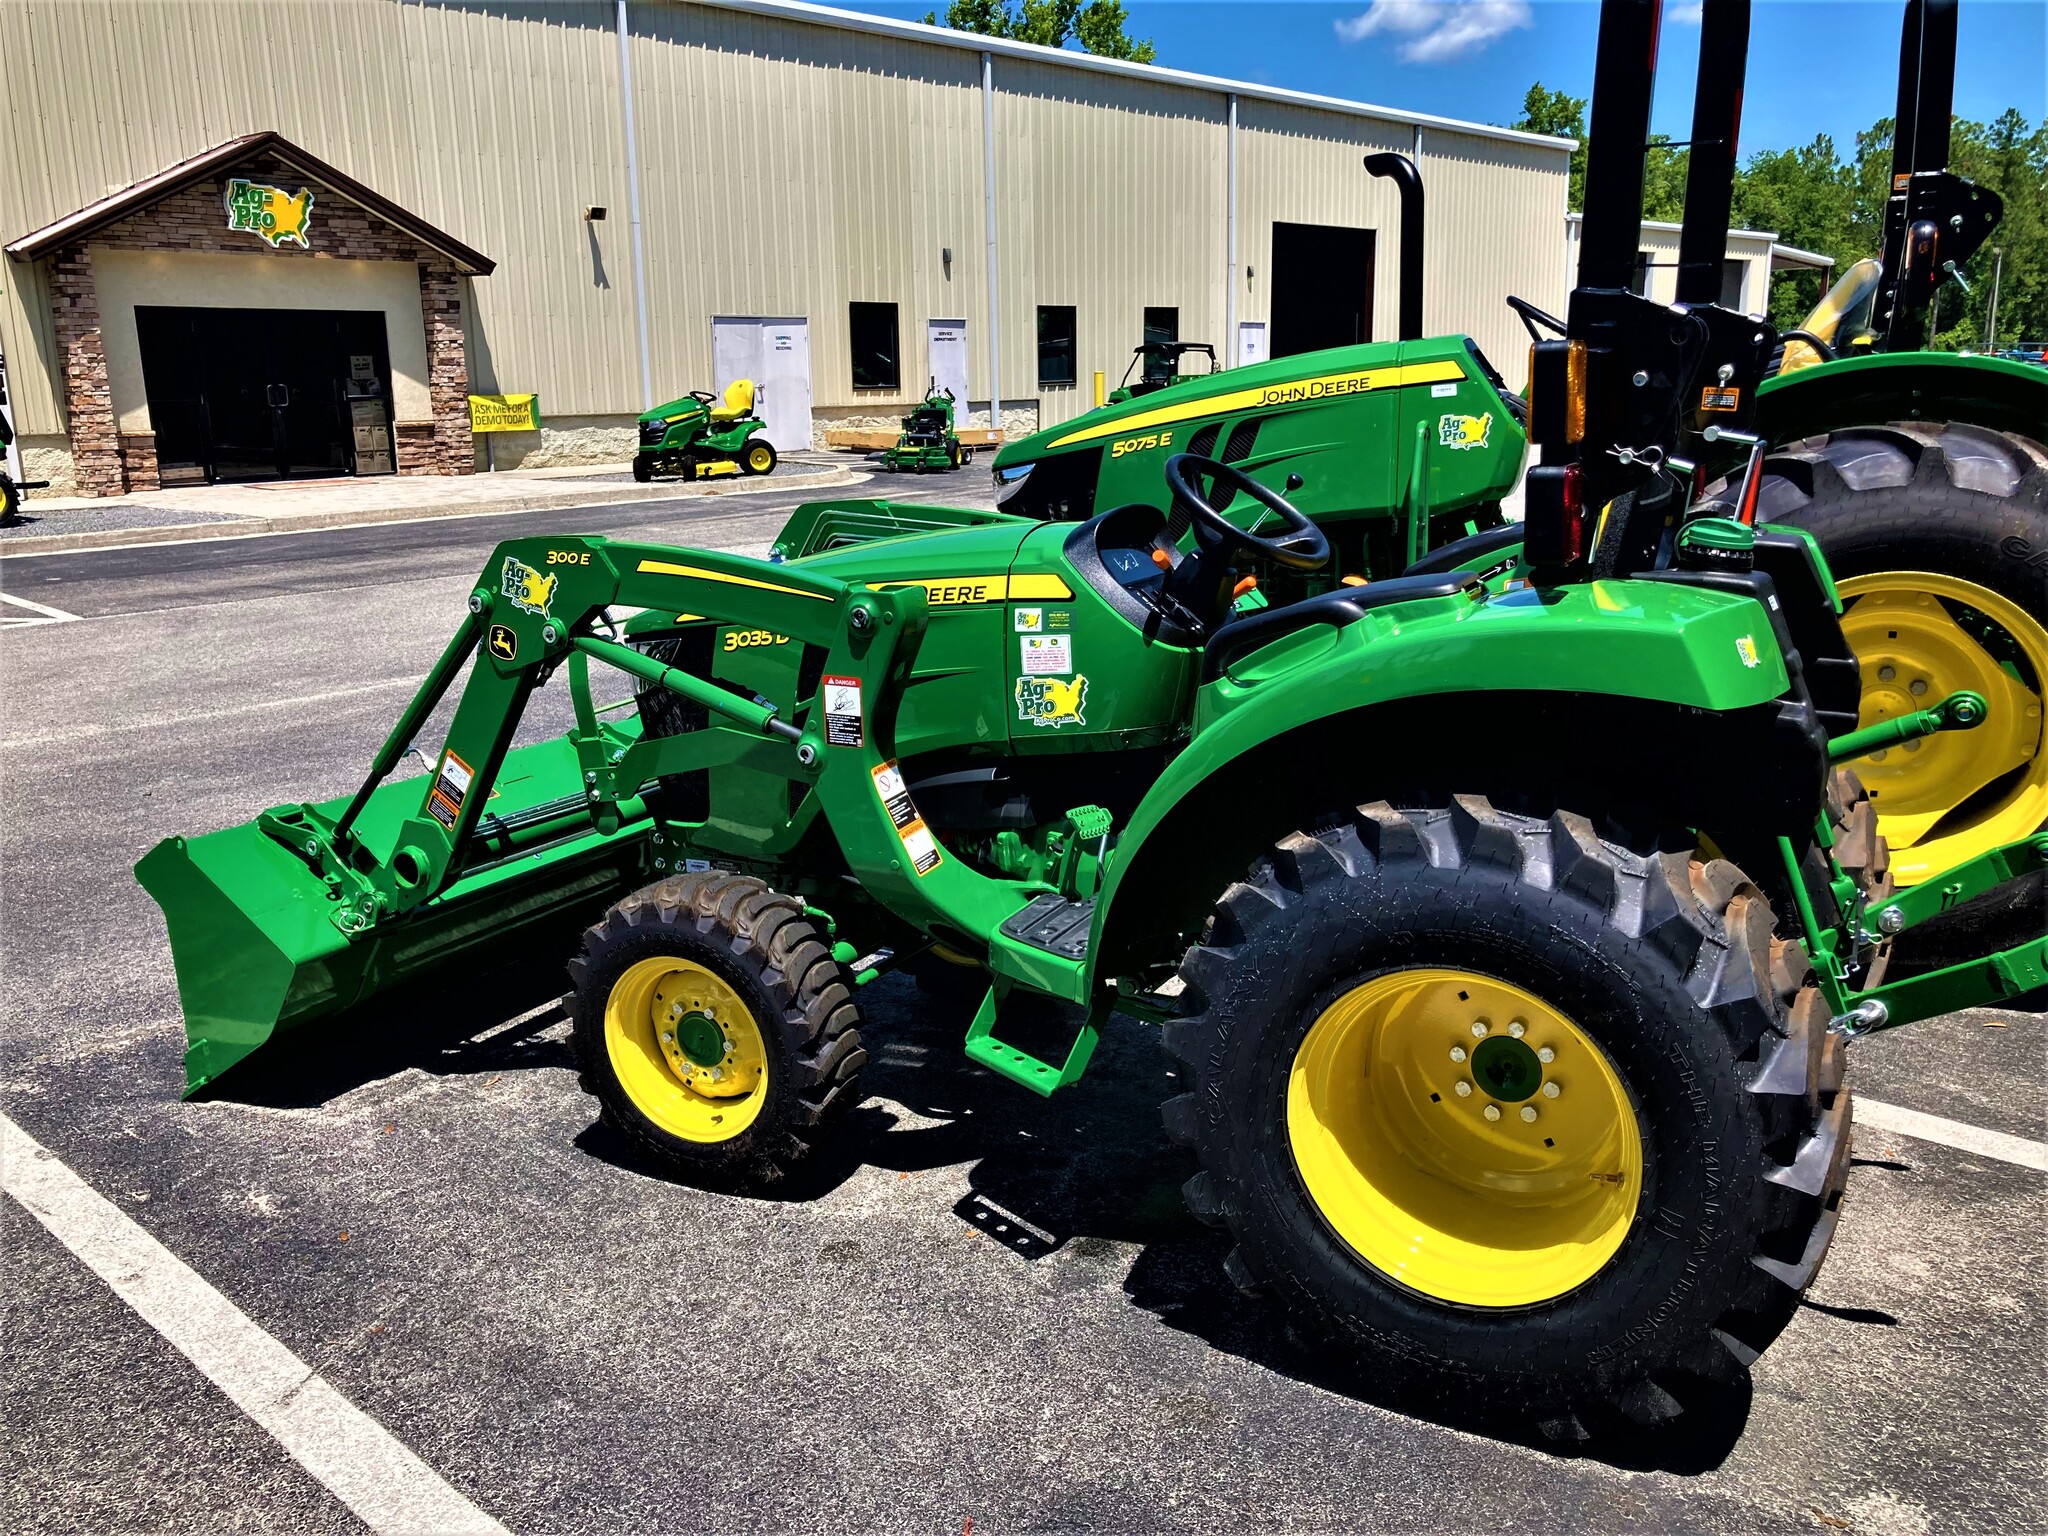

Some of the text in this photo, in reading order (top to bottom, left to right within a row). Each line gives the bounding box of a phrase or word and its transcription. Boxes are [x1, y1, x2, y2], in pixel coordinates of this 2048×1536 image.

[231, 182, 273, 211] Ag-
[233, 204, 276, 228] Pro
[1256, 377, 1371, 405] JOHN DEERE
[474, 403, 529, 415] ASK ME FOR A
[475, 414, 530, 426] DEMO TODAY!
[1442, 429, 1467, 442] Pro
[504, 576, 531, 600] Pro
[925, 585, 987, 602] EERE
[1021, 698, 1056, 716] Pro
[1669, 1041, 1712, 1127] THE
